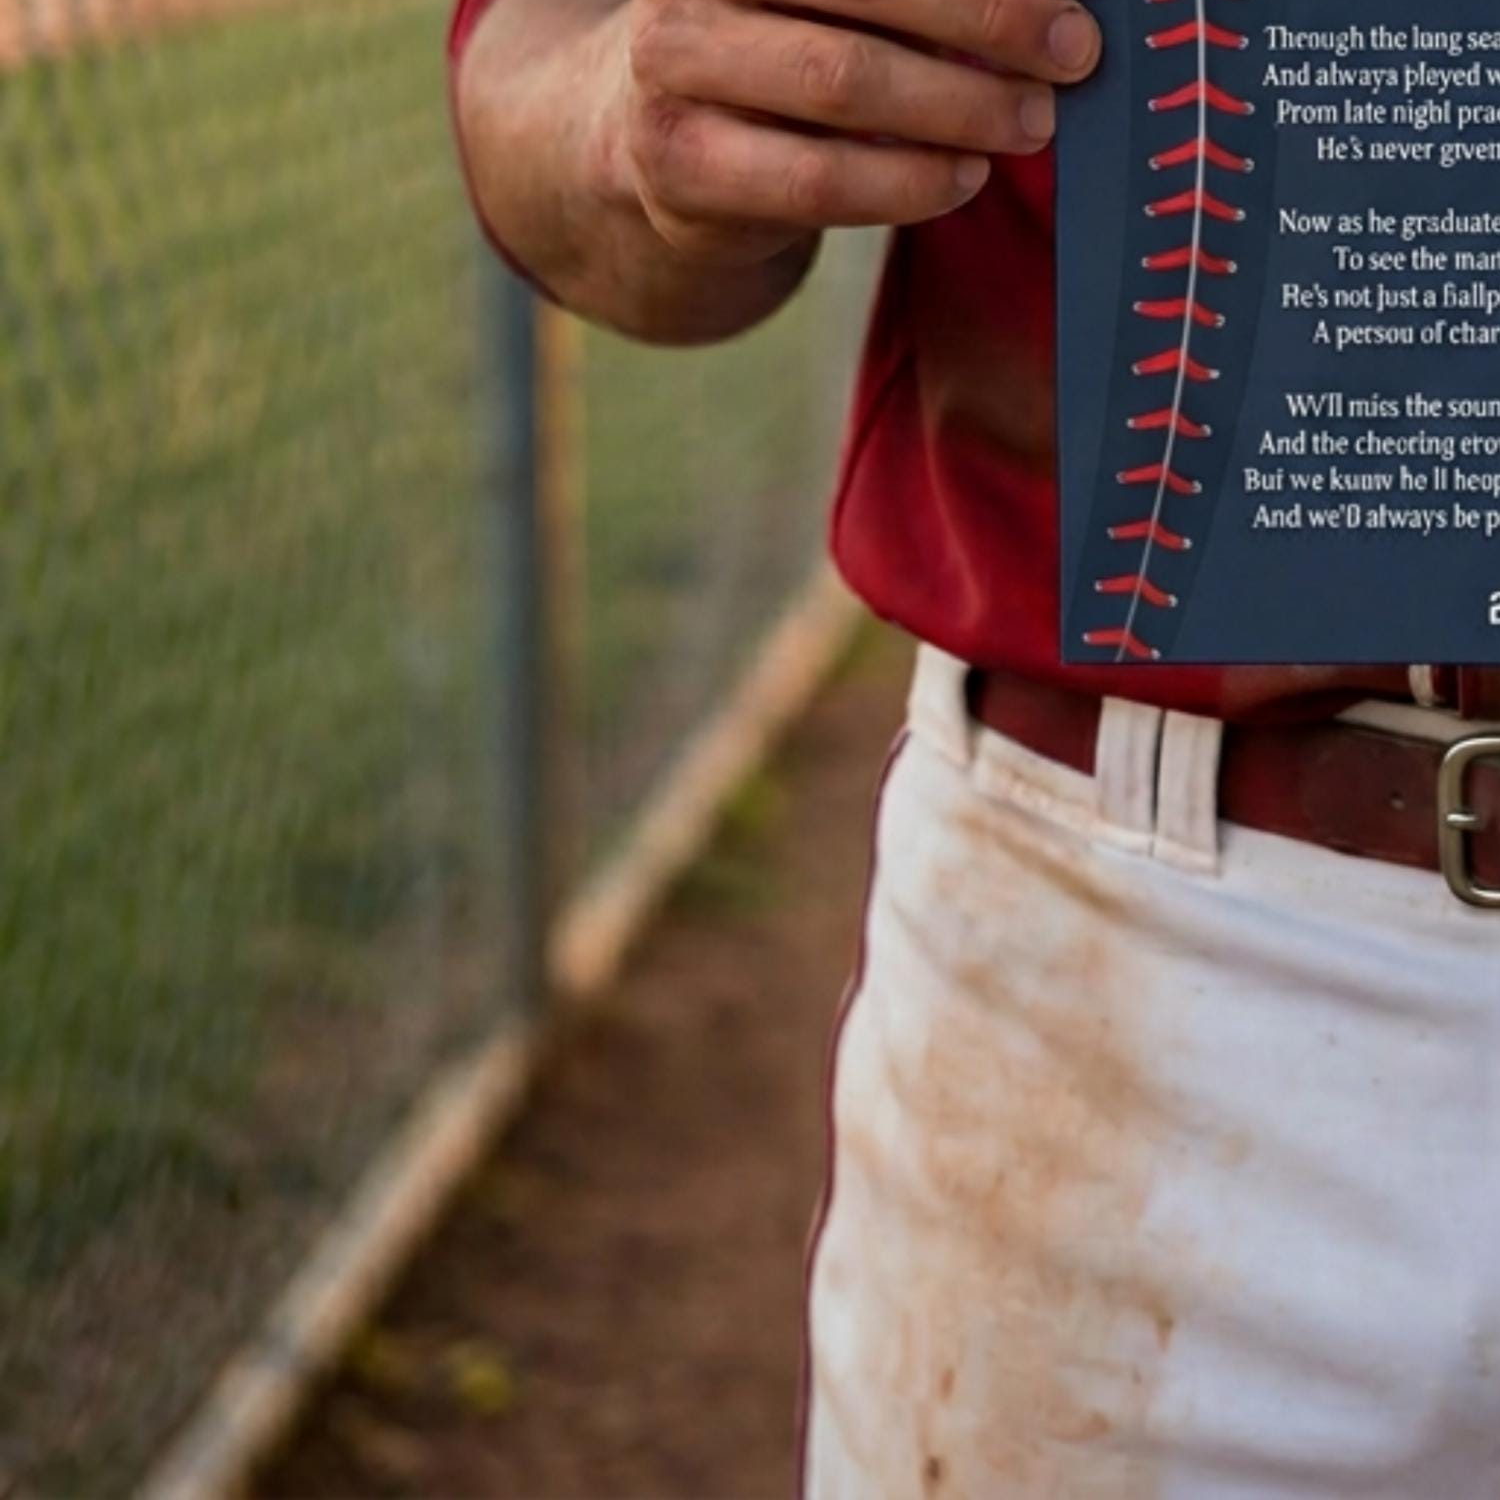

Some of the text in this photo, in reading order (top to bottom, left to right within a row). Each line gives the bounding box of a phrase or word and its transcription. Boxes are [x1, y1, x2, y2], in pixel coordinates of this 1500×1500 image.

[1262, 61, 1311, 87] And
[1344, 99, 1387, 124] late
[1317, 136, 1364, 160] He's
[1279, 208, 1333, 233] Now
[1337, 215, 1364, 234] as
[1367, 208, 1397, 234] he
[1332, 245, 1364, 271] To
[1411, 245, 1448, 271] the
[1333, 286, 1373, 308] not
[1422, 289, 1437, 308] a
[1313, 320, 1331, 344] A
[1420, 319, 1446, 344] of
[1405, 392, 1443, 418] the
[1259, 429, 1307, 455] And
[1289, 473, 1325, 491] we
[1253, 503, 1302, 528] And
[1454, 502, 1481, 529] be
